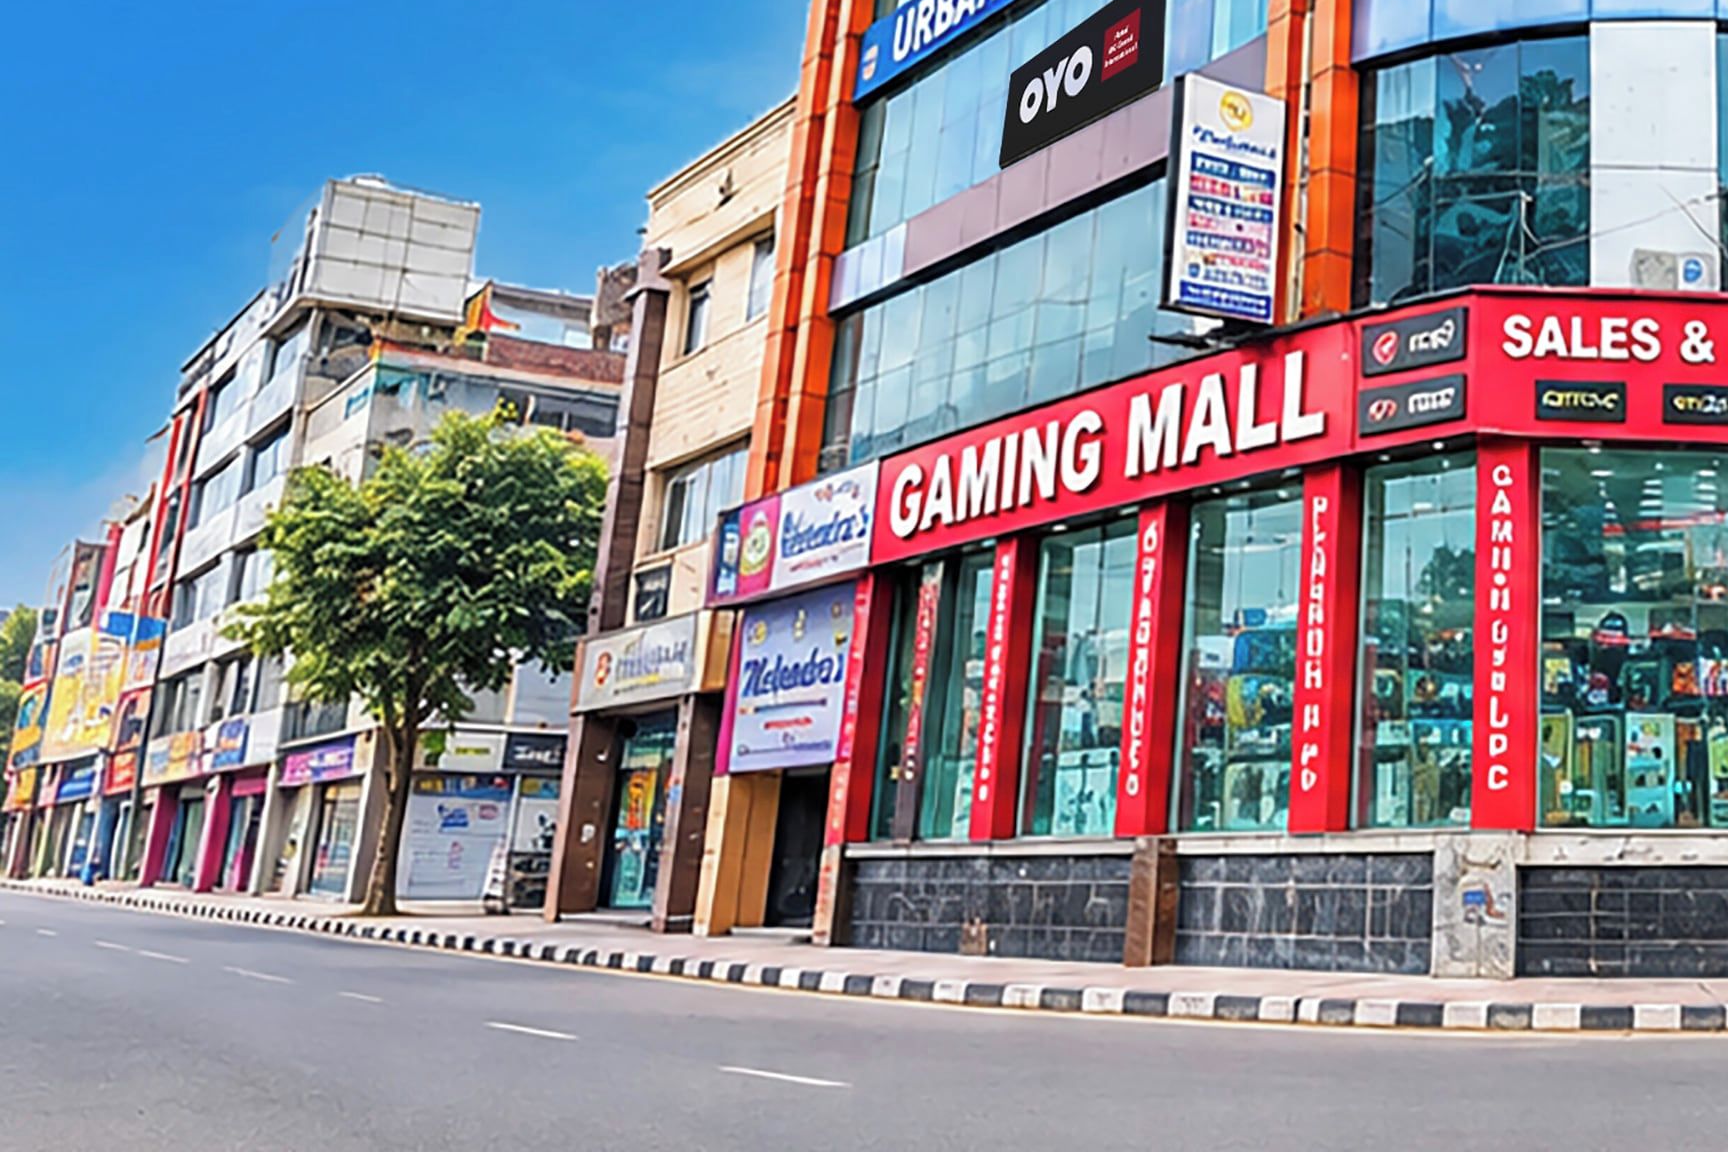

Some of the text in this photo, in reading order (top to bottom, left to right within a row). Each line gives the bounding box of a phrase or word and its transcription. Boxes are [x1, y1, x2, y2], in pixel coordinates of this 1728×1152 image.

[1019, 45, 1093, 123] OYO
[1502, 314, 1662, 360] SALES
[1680, 320, 1715, 362] &
[889, 350, 1325, 538] GAMING MALL
